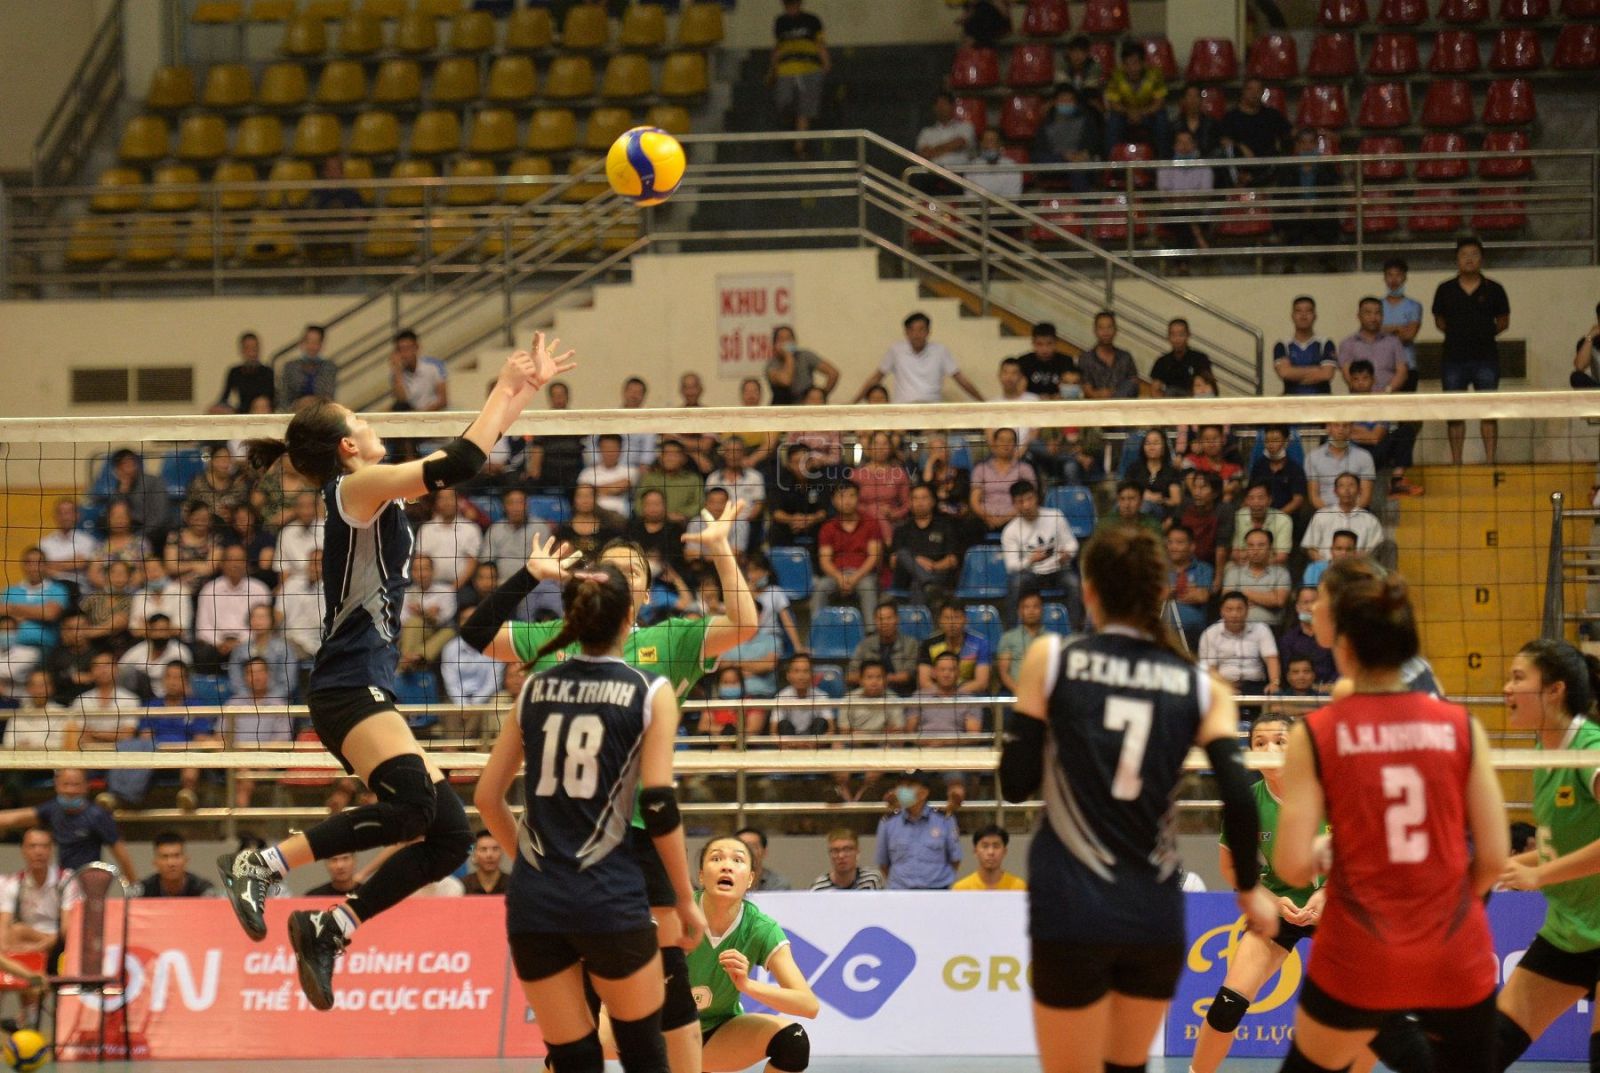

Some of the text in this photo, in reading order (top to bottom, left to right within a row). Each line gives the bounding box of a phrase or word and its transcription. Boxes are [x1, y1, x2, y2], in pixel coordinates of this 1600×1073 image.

[721, 287, 790, 316] KHU C
[1494, 472, 1506, 488] F
[1486, 531, 1498, 546] E
[1475, 585, 1489, 604] D
[1467, 652, 1482, 669] C
[535, 713, 605, 799] 18
[1103, 695, 1154, 801] 7
[1380, 764, 1429, 864] 2
[418, 951, 472, 974] CAO
[842, 953, 882, 992] C
[942, 955, 1033, 992] GR
[294, 988, 367, 1011] TAO
[422, 979, 493, 1011] CHẤT
[1185, 1023, 1249, 1041] ĐG
